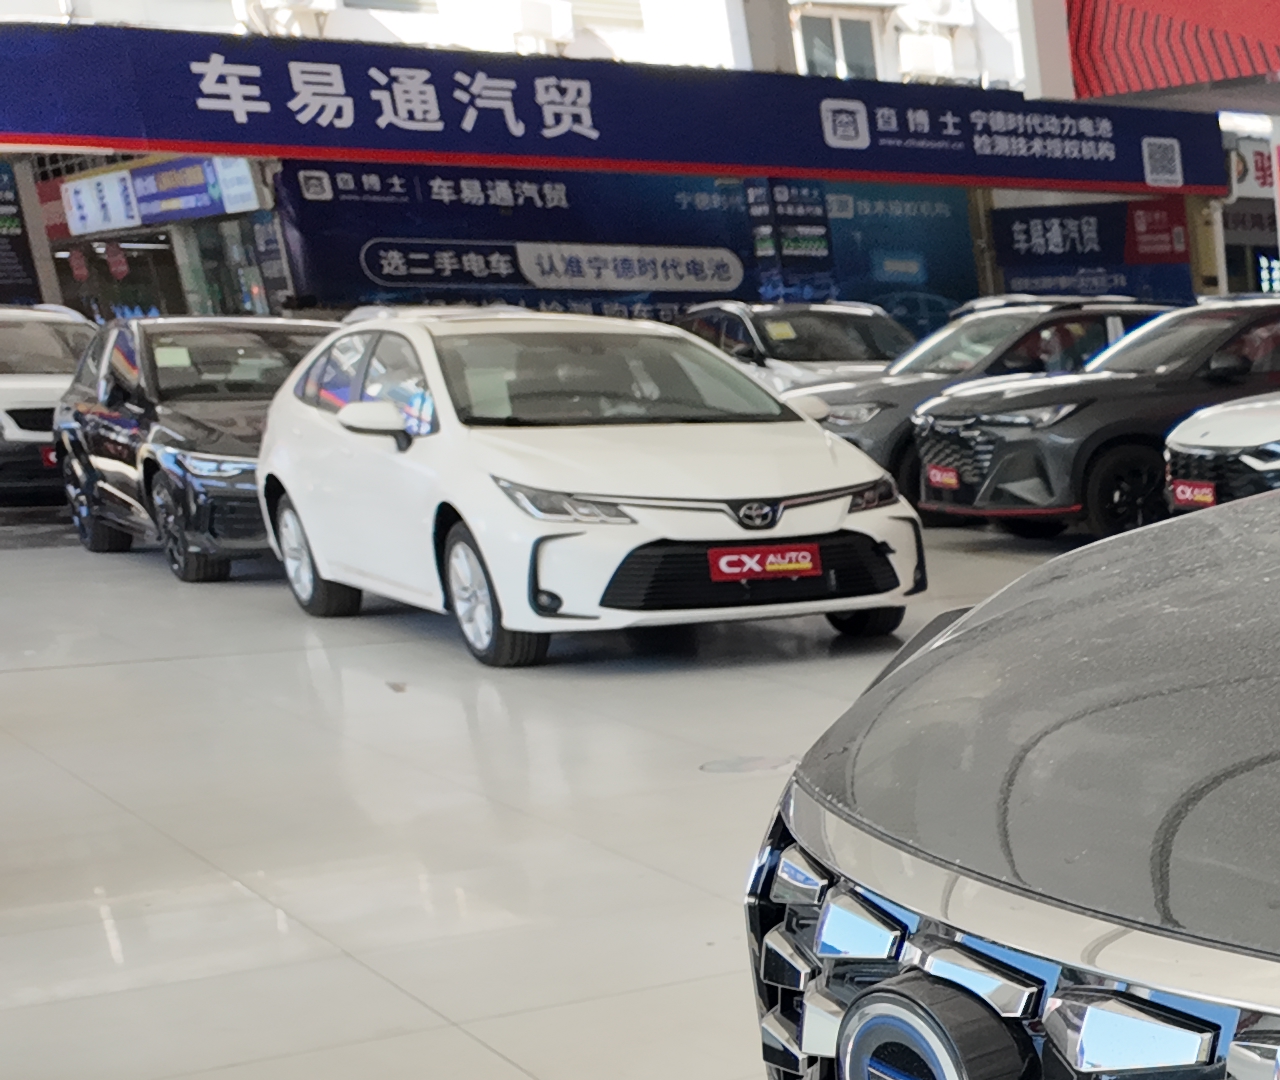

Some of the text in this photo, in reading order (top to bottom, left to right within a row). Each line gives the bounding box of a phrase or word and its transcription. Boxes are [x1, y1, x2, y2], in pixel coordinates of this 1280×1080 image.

[190, 53, 600, 139] 车易通汽贸
[874, 107, 961, 135] 查博士
[969, 109, 1113, 138] 宁德时代动力电池
[973, 133, 1116, 161] 检测技术授权机构
[428, 175, 569, 208] 车易通汽贸
[1011, 216, 1100, 255] 车易通汽贸
[379, 249, 732, 283] 选二手电车 认准宁德时代电池
[718, 551, 812, 574] CX AUTO
